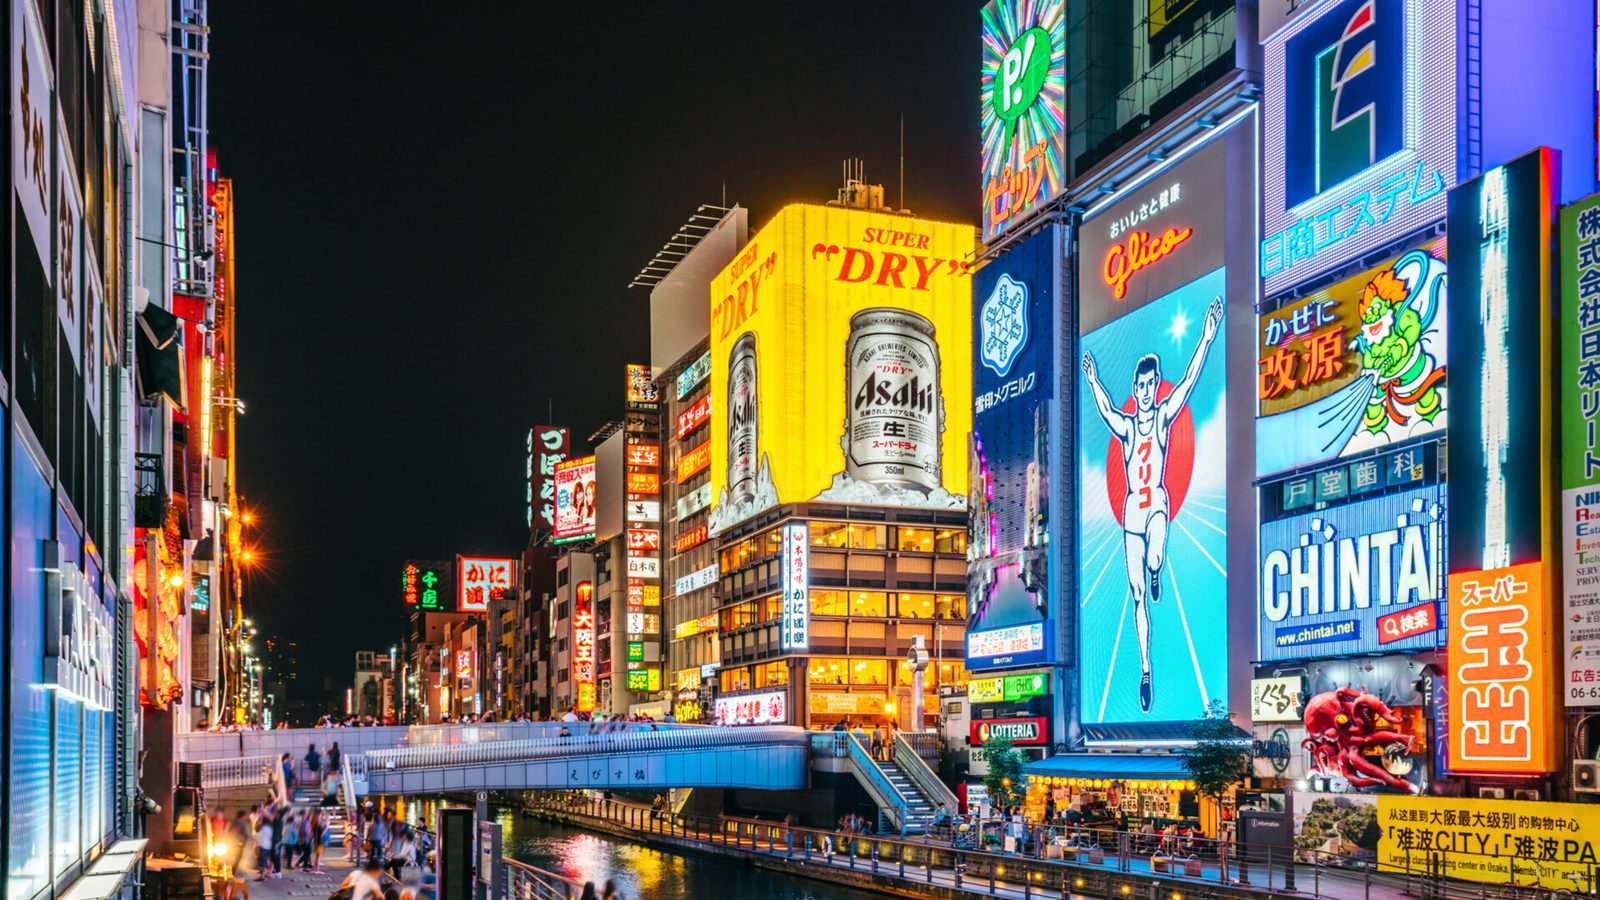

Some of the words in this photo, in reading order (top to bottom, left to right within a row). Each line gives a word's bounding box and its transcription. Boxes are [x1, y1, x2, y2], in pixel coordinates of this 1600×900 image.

[990, 138, 1048, 225] ピップ
[1110, 183, 1180, 239] おいしさと健康
[1262, 161, 1443, 278] 日商エステム
[863, 227, 930, 250] SUPER
[730, 243, 758, 285] SUPER
[1264, 300, 1335, 346] かぜに
[1258, 326, 1344, 400] 改源
[855, 371, 932, 415] Asahi
[975, 372, 1035, 414] 雪印メグミルク
[731, 392, 755, 437] Asahi
[883, 421, 906, 438] 生
[872, 440, 918, 451] スーパードライ
[885, 466, 904, 475] 350ml
[1137, 436, 1153, 509] グリコ
[466, 563, 506, 583] かに
[630, 560, 656, 572] 白木屋
[423, 571, 438, 604] 千房
[1461, 575, 1527, 606] スーパー
[793, 588, 804, 643] かに道楽
[1401, 612, 1429, 633] 検索
[1458, 604, 1533, 761] 玉出
[991, 724, 1033, 738] LOTTERIA
[570, 769, 645, 781] えびす橋
[1458, 860, 1478, 870] center
[1480, 861, 1486, 869] in
